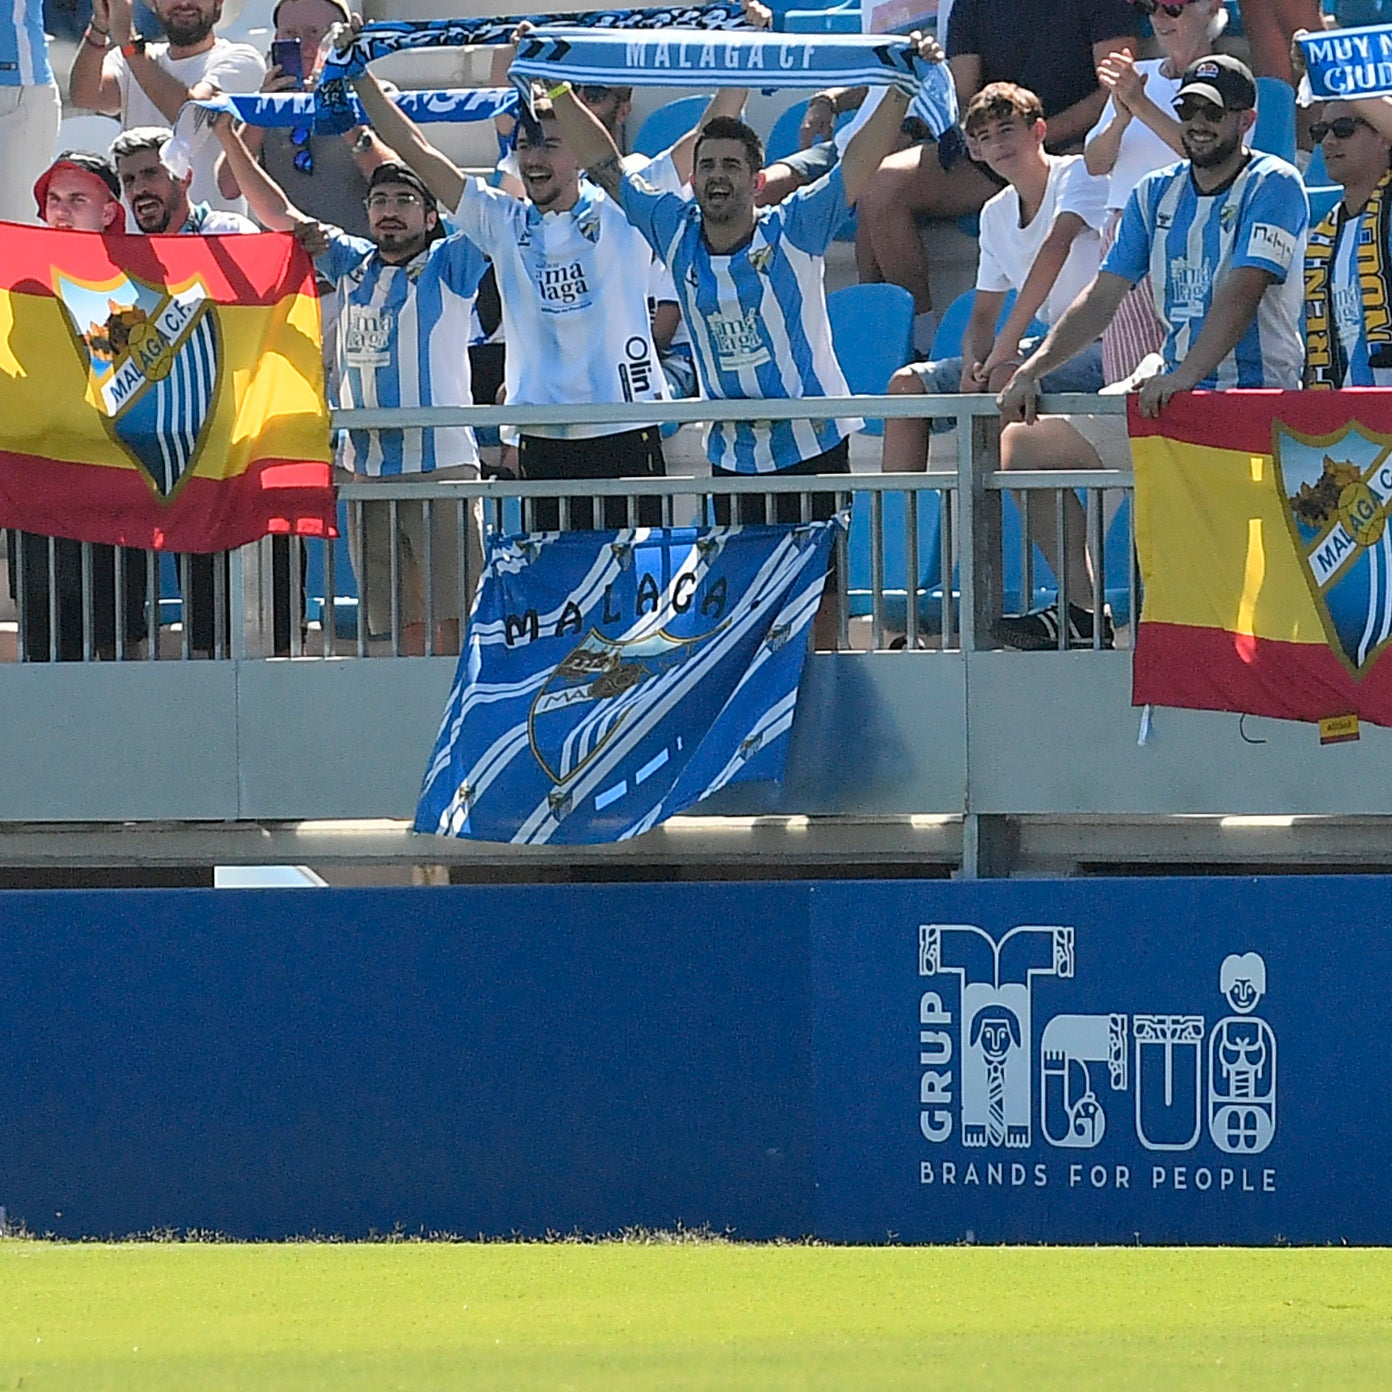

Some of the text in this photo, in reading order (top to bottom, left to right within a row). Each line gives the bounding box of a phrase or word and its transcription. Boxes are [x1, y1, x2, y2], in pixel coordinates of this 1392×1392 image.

[625, 36, 818, 70] MALAGA CF
[1309, 36, 1370, 66] MUY
[539, 278, 589, 304] laga
[110, 299, 192, 404] MALAGA C.F.
[1316, 487, 1385, 573] MALAGA
[505, 571, 729, 646] MALAGA
[919, 991, 953, 1144] GRUP
[920, 1161, 1277, 1193] BRANDS FOR PEOPLE
